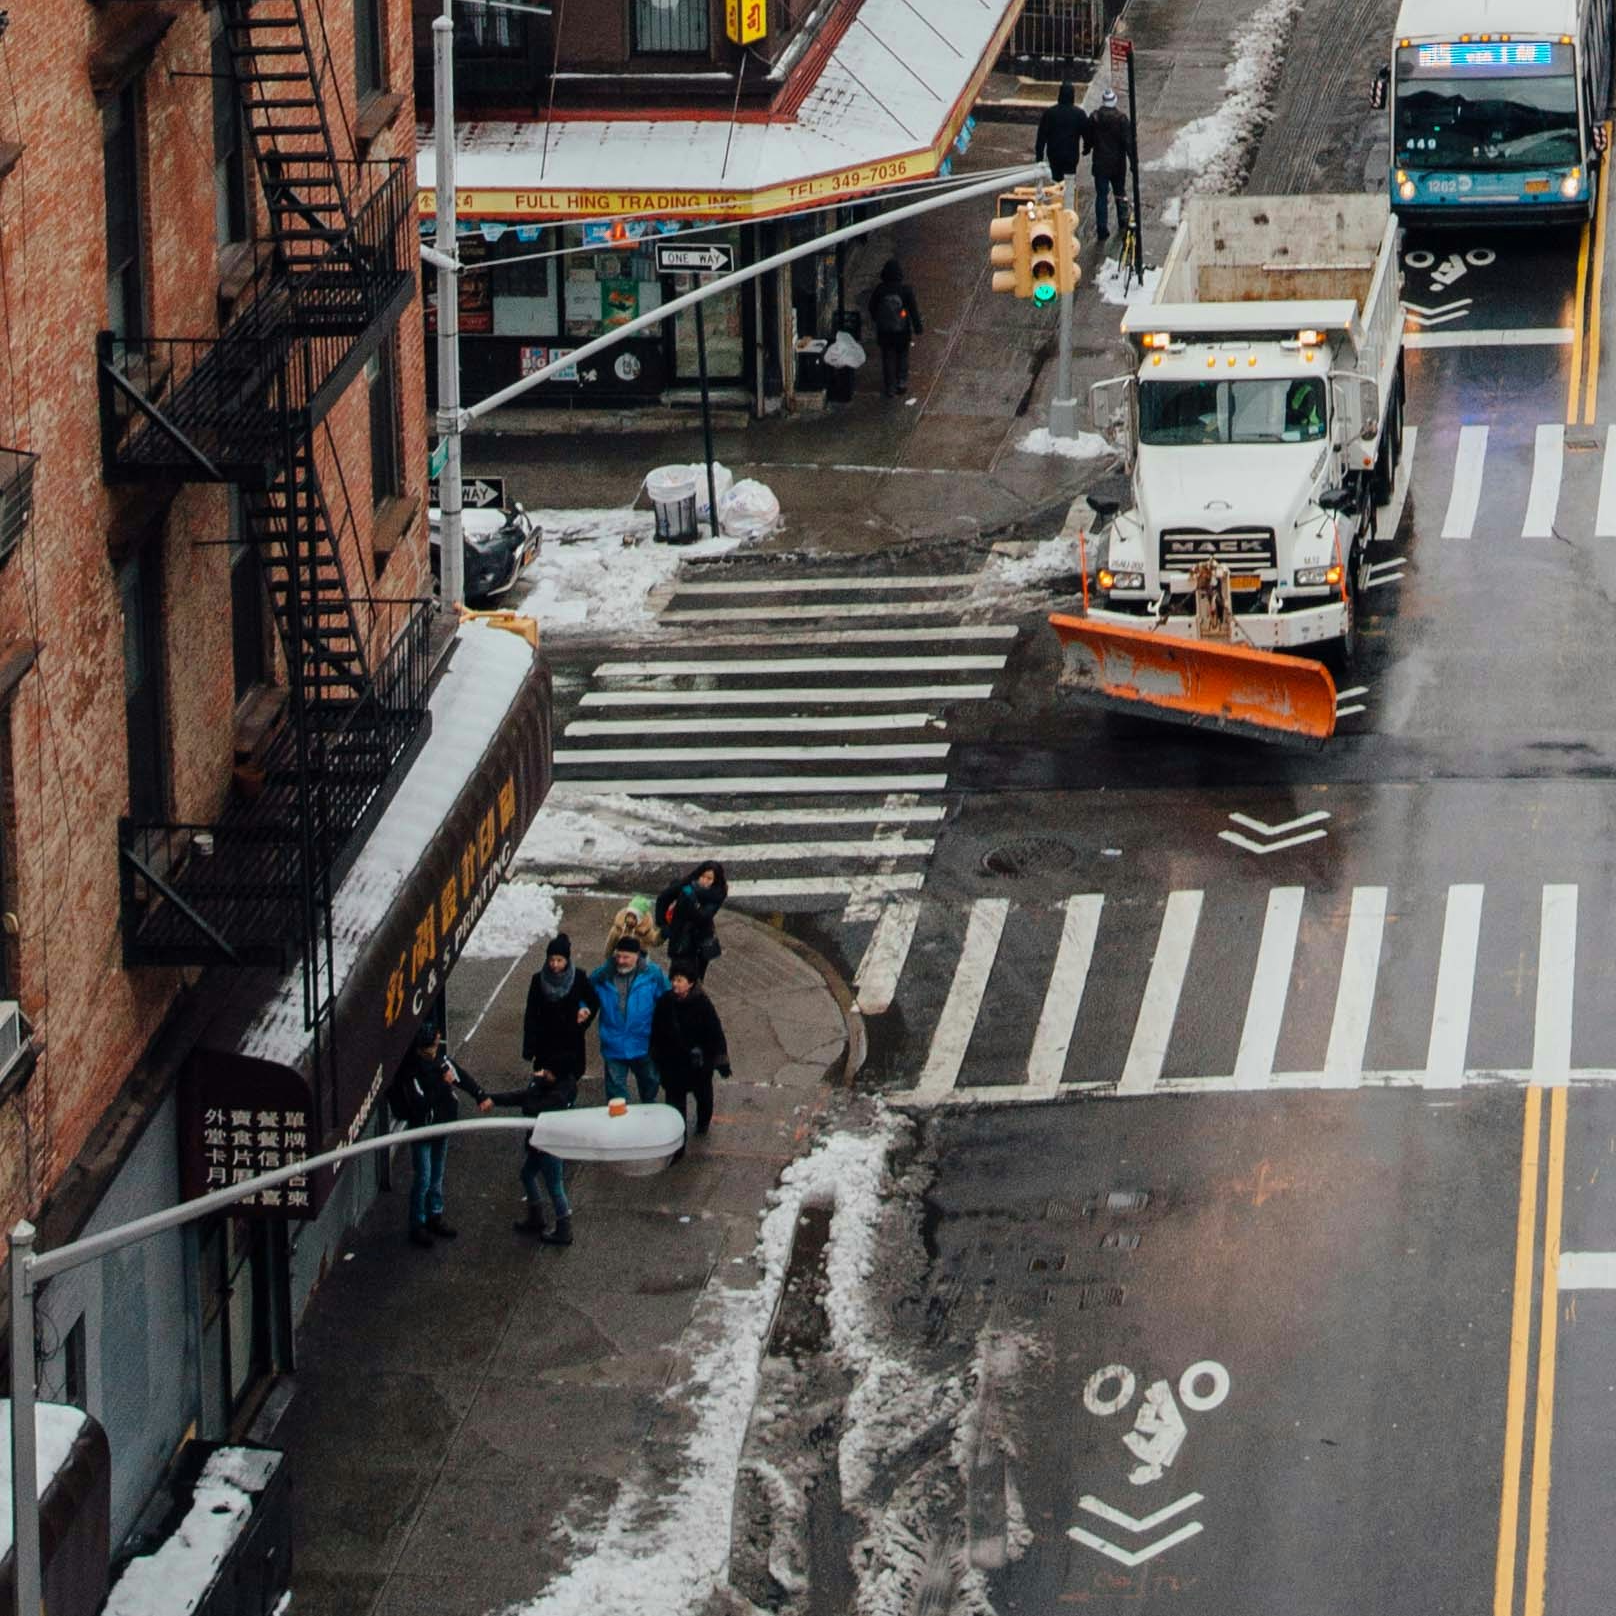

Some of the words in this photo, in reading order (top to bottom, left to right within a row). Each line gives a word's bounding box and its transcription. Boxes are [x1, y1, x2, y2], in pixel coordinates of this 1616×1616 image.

[831, 161, 908, 193] 349-7036
[515, 195, 560, 210] FULL
[566, 195, 611, 210] HING
[617, 195, 700, 210] TRADING
[707, 195, 743, 210] INC.
[667, 253, 689, 264] ONE
[699, 253, 721, 265] WAY
[462, 487, 489, 501] WAY
[1171, 540, 1264, 553] MACK
[411, 988, 423, 1016] C
[427, 967, 437, 995] &
[442, 944, 451, 971] S
[454, 841, 511, 952] PRINTING
[204, 1108, 307, 1128] 外賣餐單
[204, 1127, 307, 1148] 堂食餐牌
